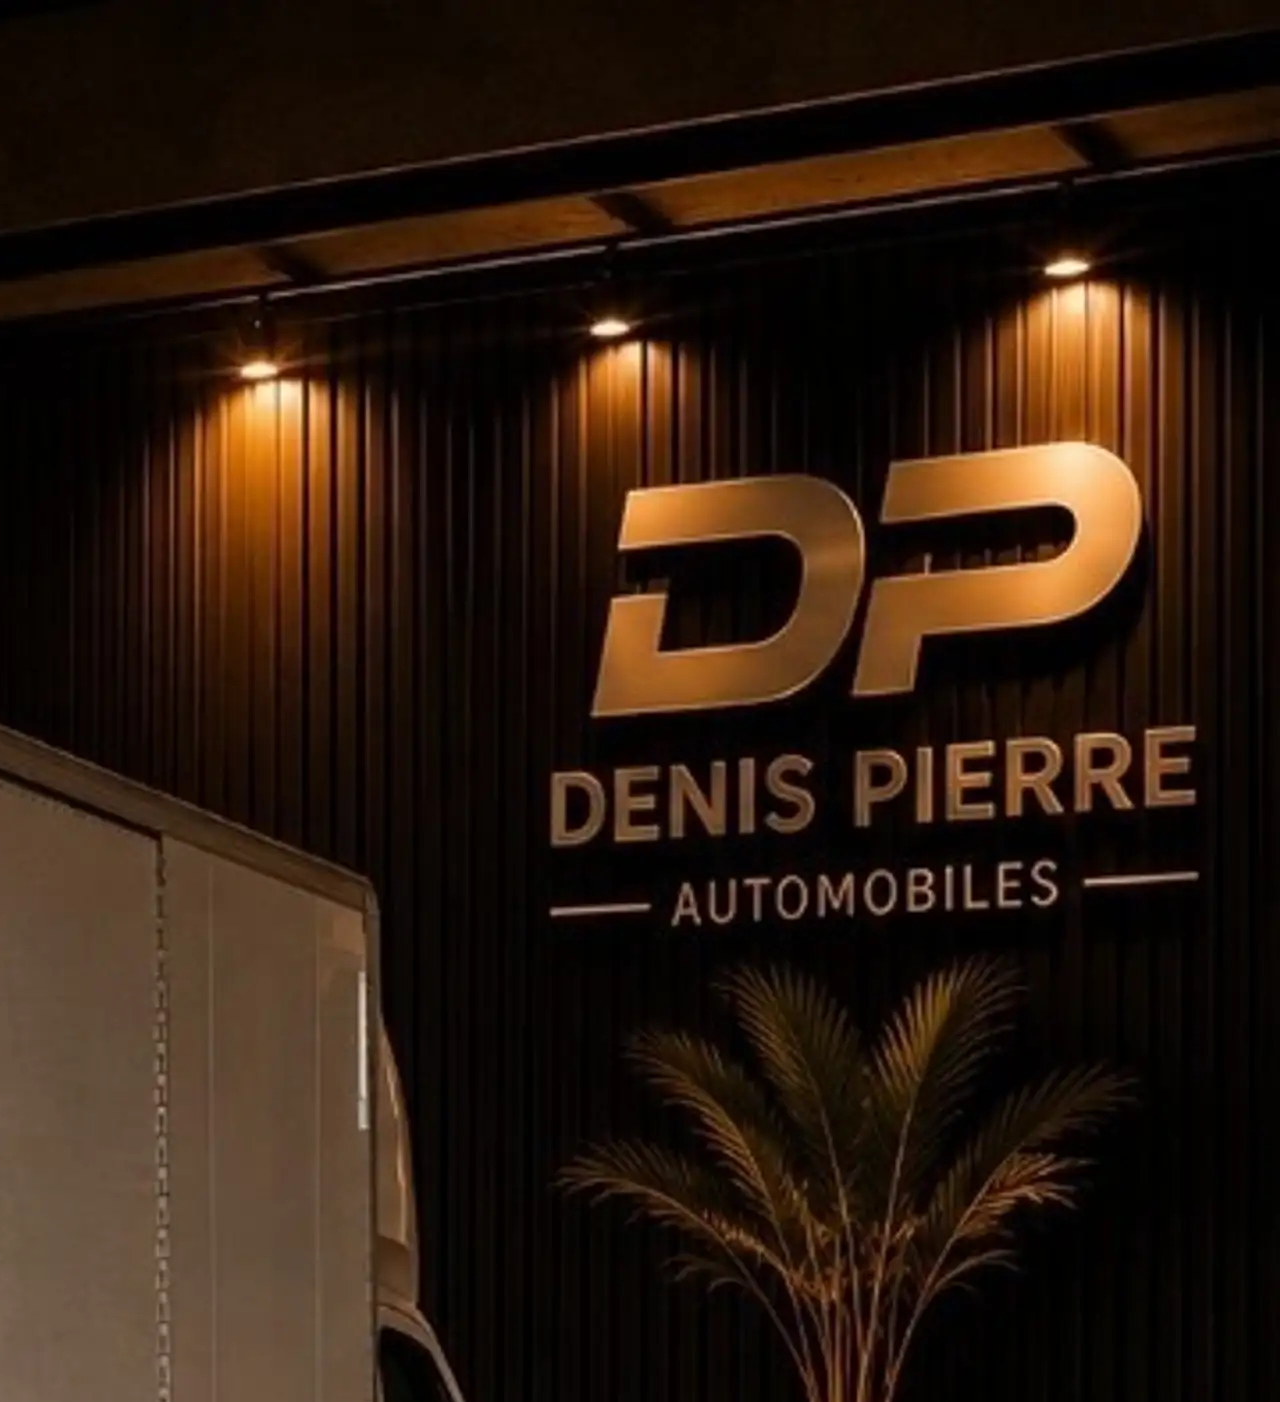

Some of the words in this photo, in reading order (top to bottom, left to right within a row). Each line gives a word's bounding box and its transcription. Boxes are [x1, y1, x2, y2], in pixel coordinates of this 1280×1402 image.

[592, 441, 1142, 718] DP
[550, 754, 815, 846] DENIS
[853, 726, 1197, 828] PIERRE
[671, 860, 1059, 926] AUTOMOBILES
